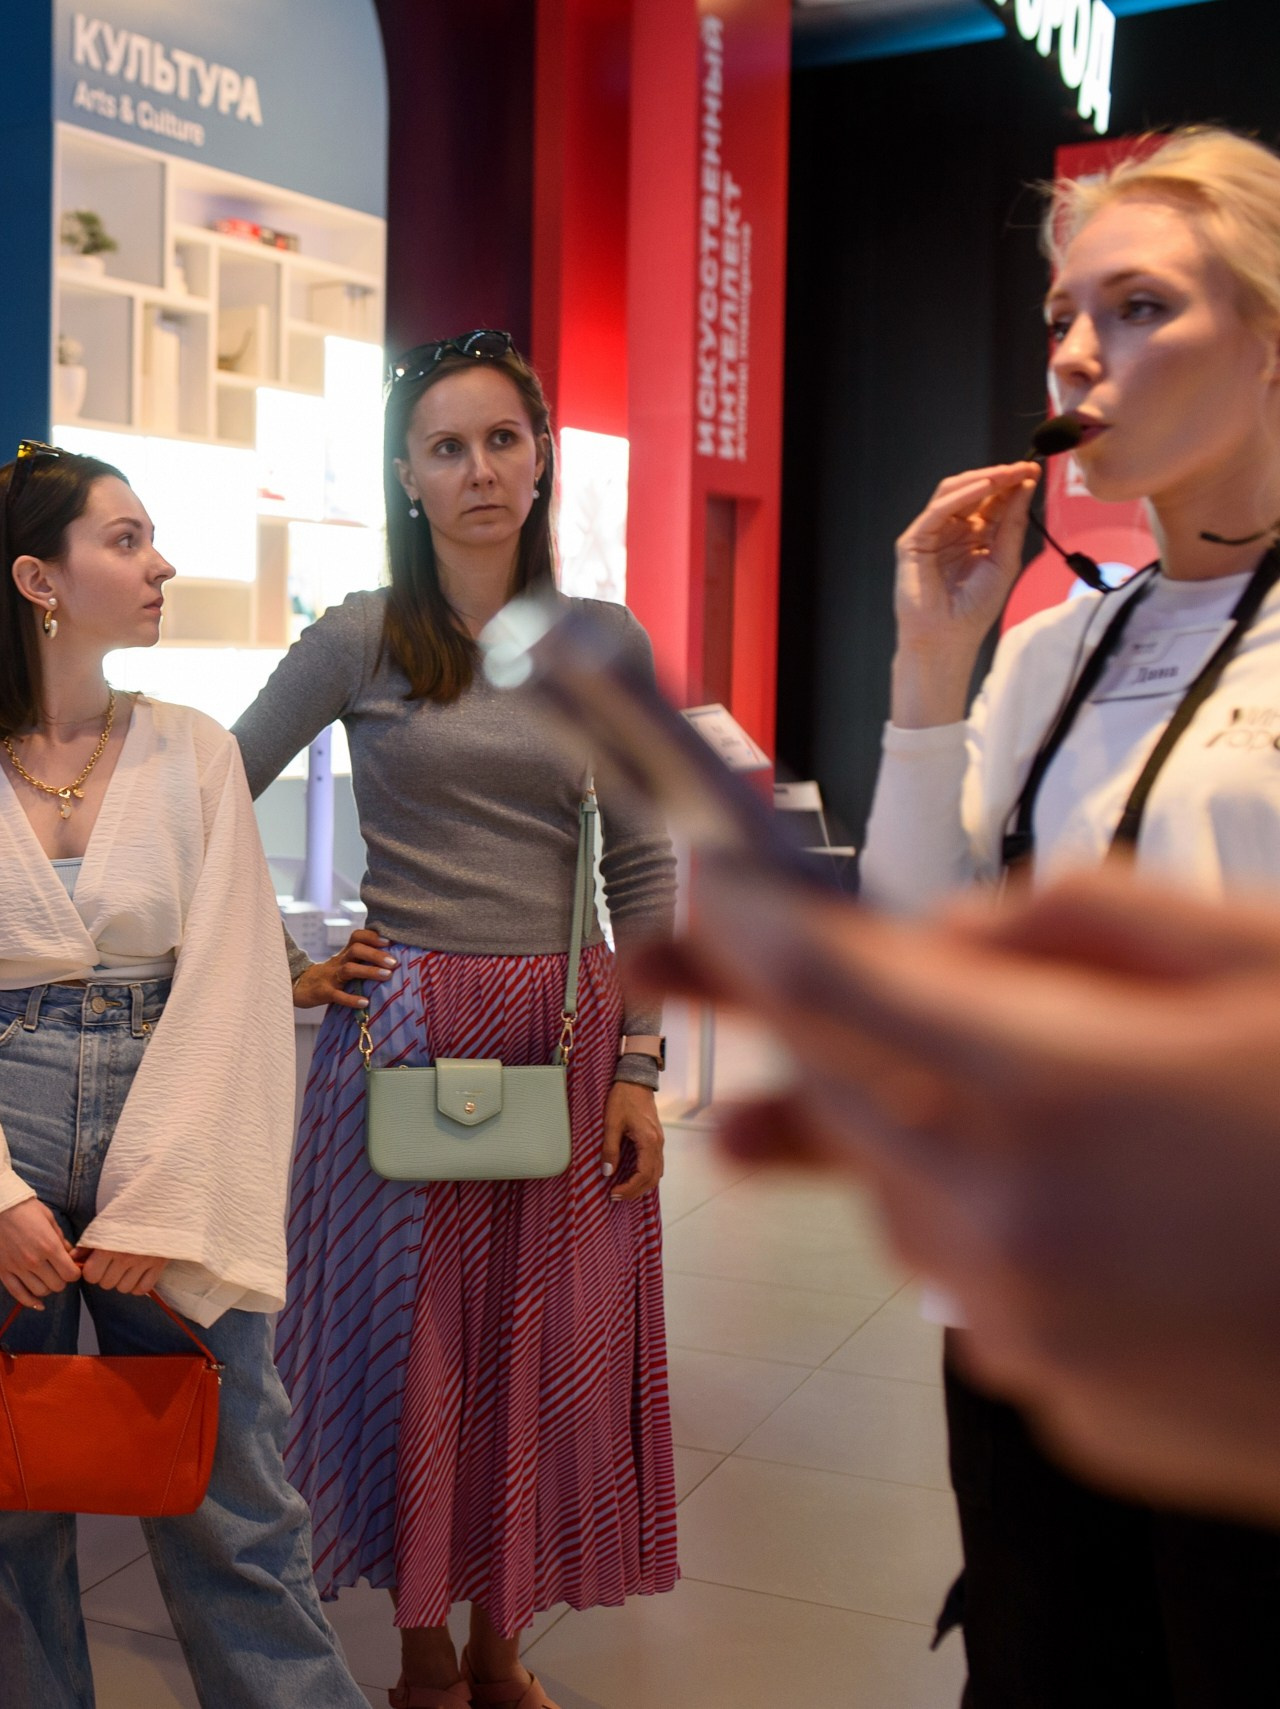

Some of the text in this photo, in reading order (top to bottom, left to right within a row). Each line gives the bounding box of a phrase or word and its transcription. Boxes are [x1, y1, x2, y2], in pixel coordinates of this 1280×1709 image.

[74, 13, 264, 127] КУЛЬТУРА
[74, 80, 205, 148] Arts & Culture
[697, 15, 724, 457] ИСКУССТВЕННЫЙ
[718, 172, 742, 460] ИНТЕЛЛЕКТ
